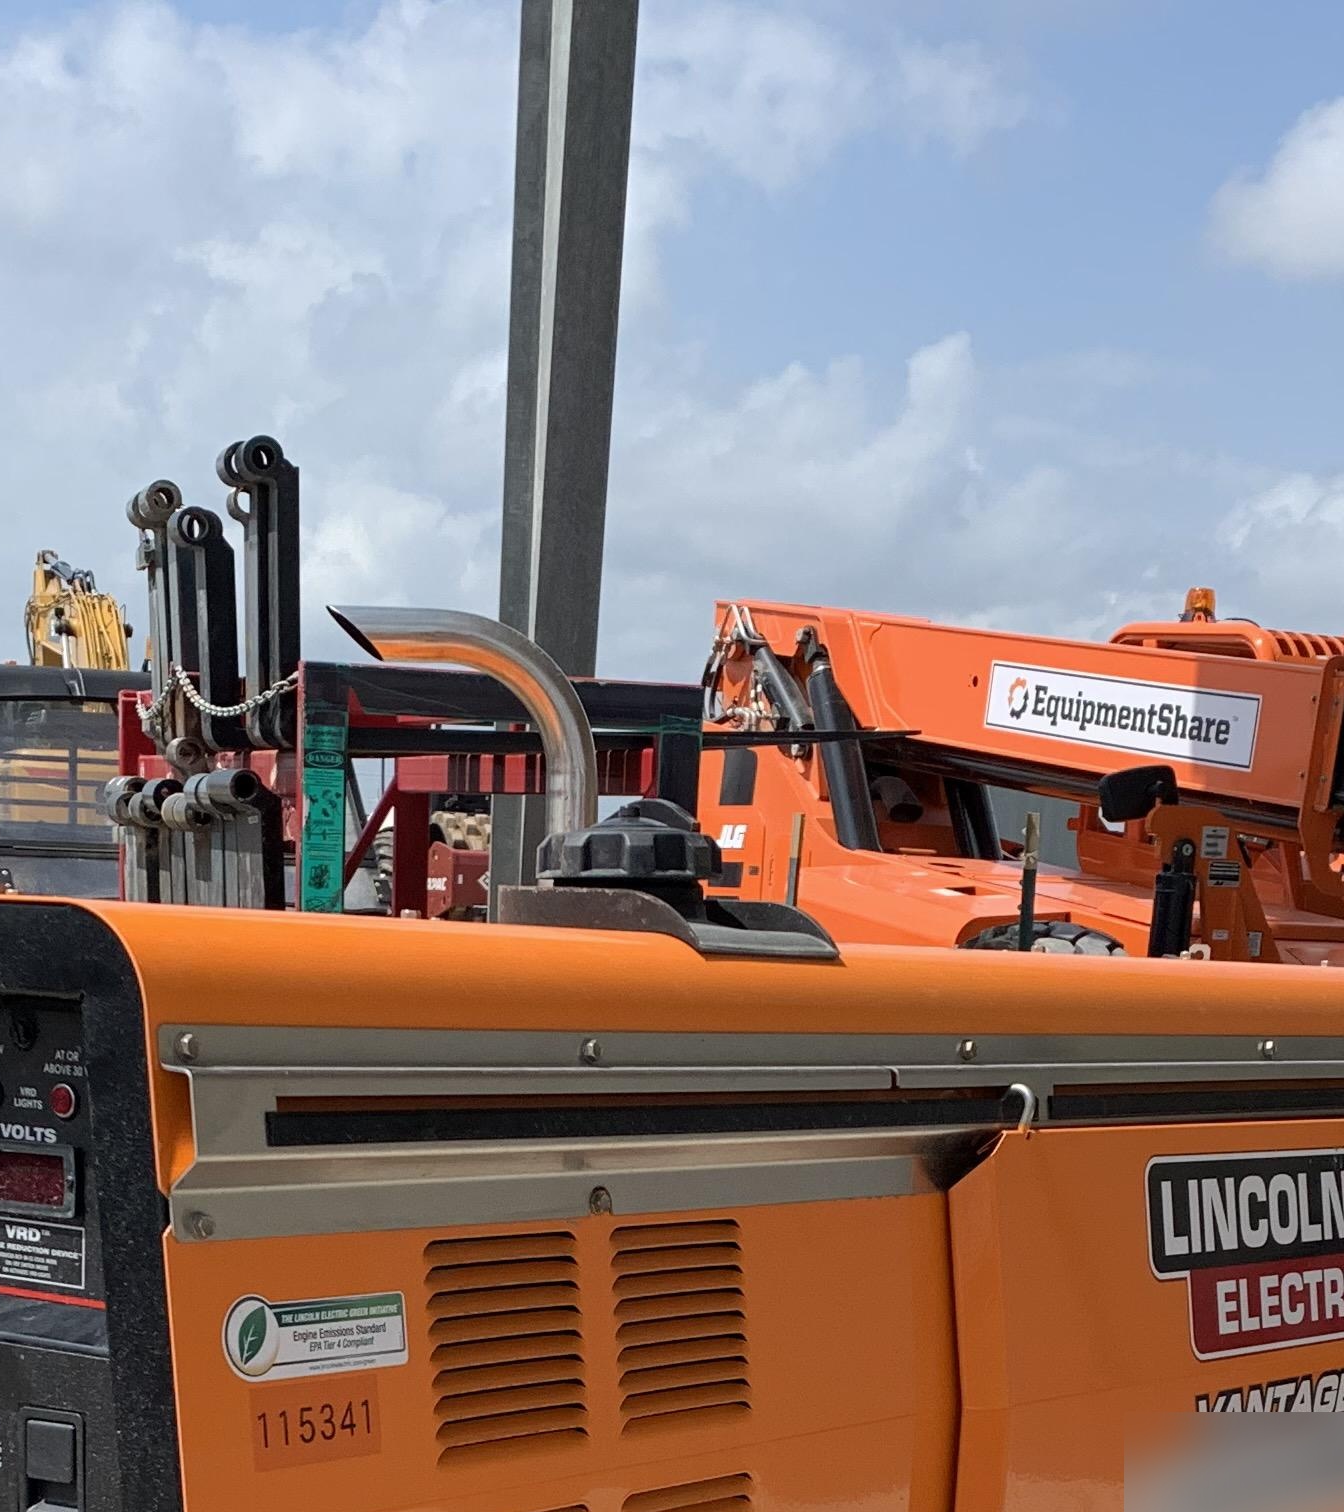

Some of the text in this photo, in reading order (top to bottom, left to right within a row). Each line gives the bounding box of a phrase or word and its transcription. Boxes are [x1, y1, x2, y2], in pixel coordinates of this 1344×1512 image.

[1032, 684, 1231, 746] EquipmentShare
[43, 1063, 70, 1076] ABOVE
[20, 1087, 37, 1098] VRD
[14, 1097, 44, 1111] LIGHTS
[0, 1122, 58, 1144] VOLTS
[281, 1312, 294, 1324] THE
[294, 1311, 321, 1323] LINCOLN
[320, 1308, 349, 1321] ELECTRIC
[293, 1322, 387, 1343] Engine Emissions Standard
[309, 1341, 322, 1352] EPA
[323, 1339, 336, 1350] Tier
[342, 1335, 374, 1350] Compliant
[257, 1399, 372, 1449] 115341
